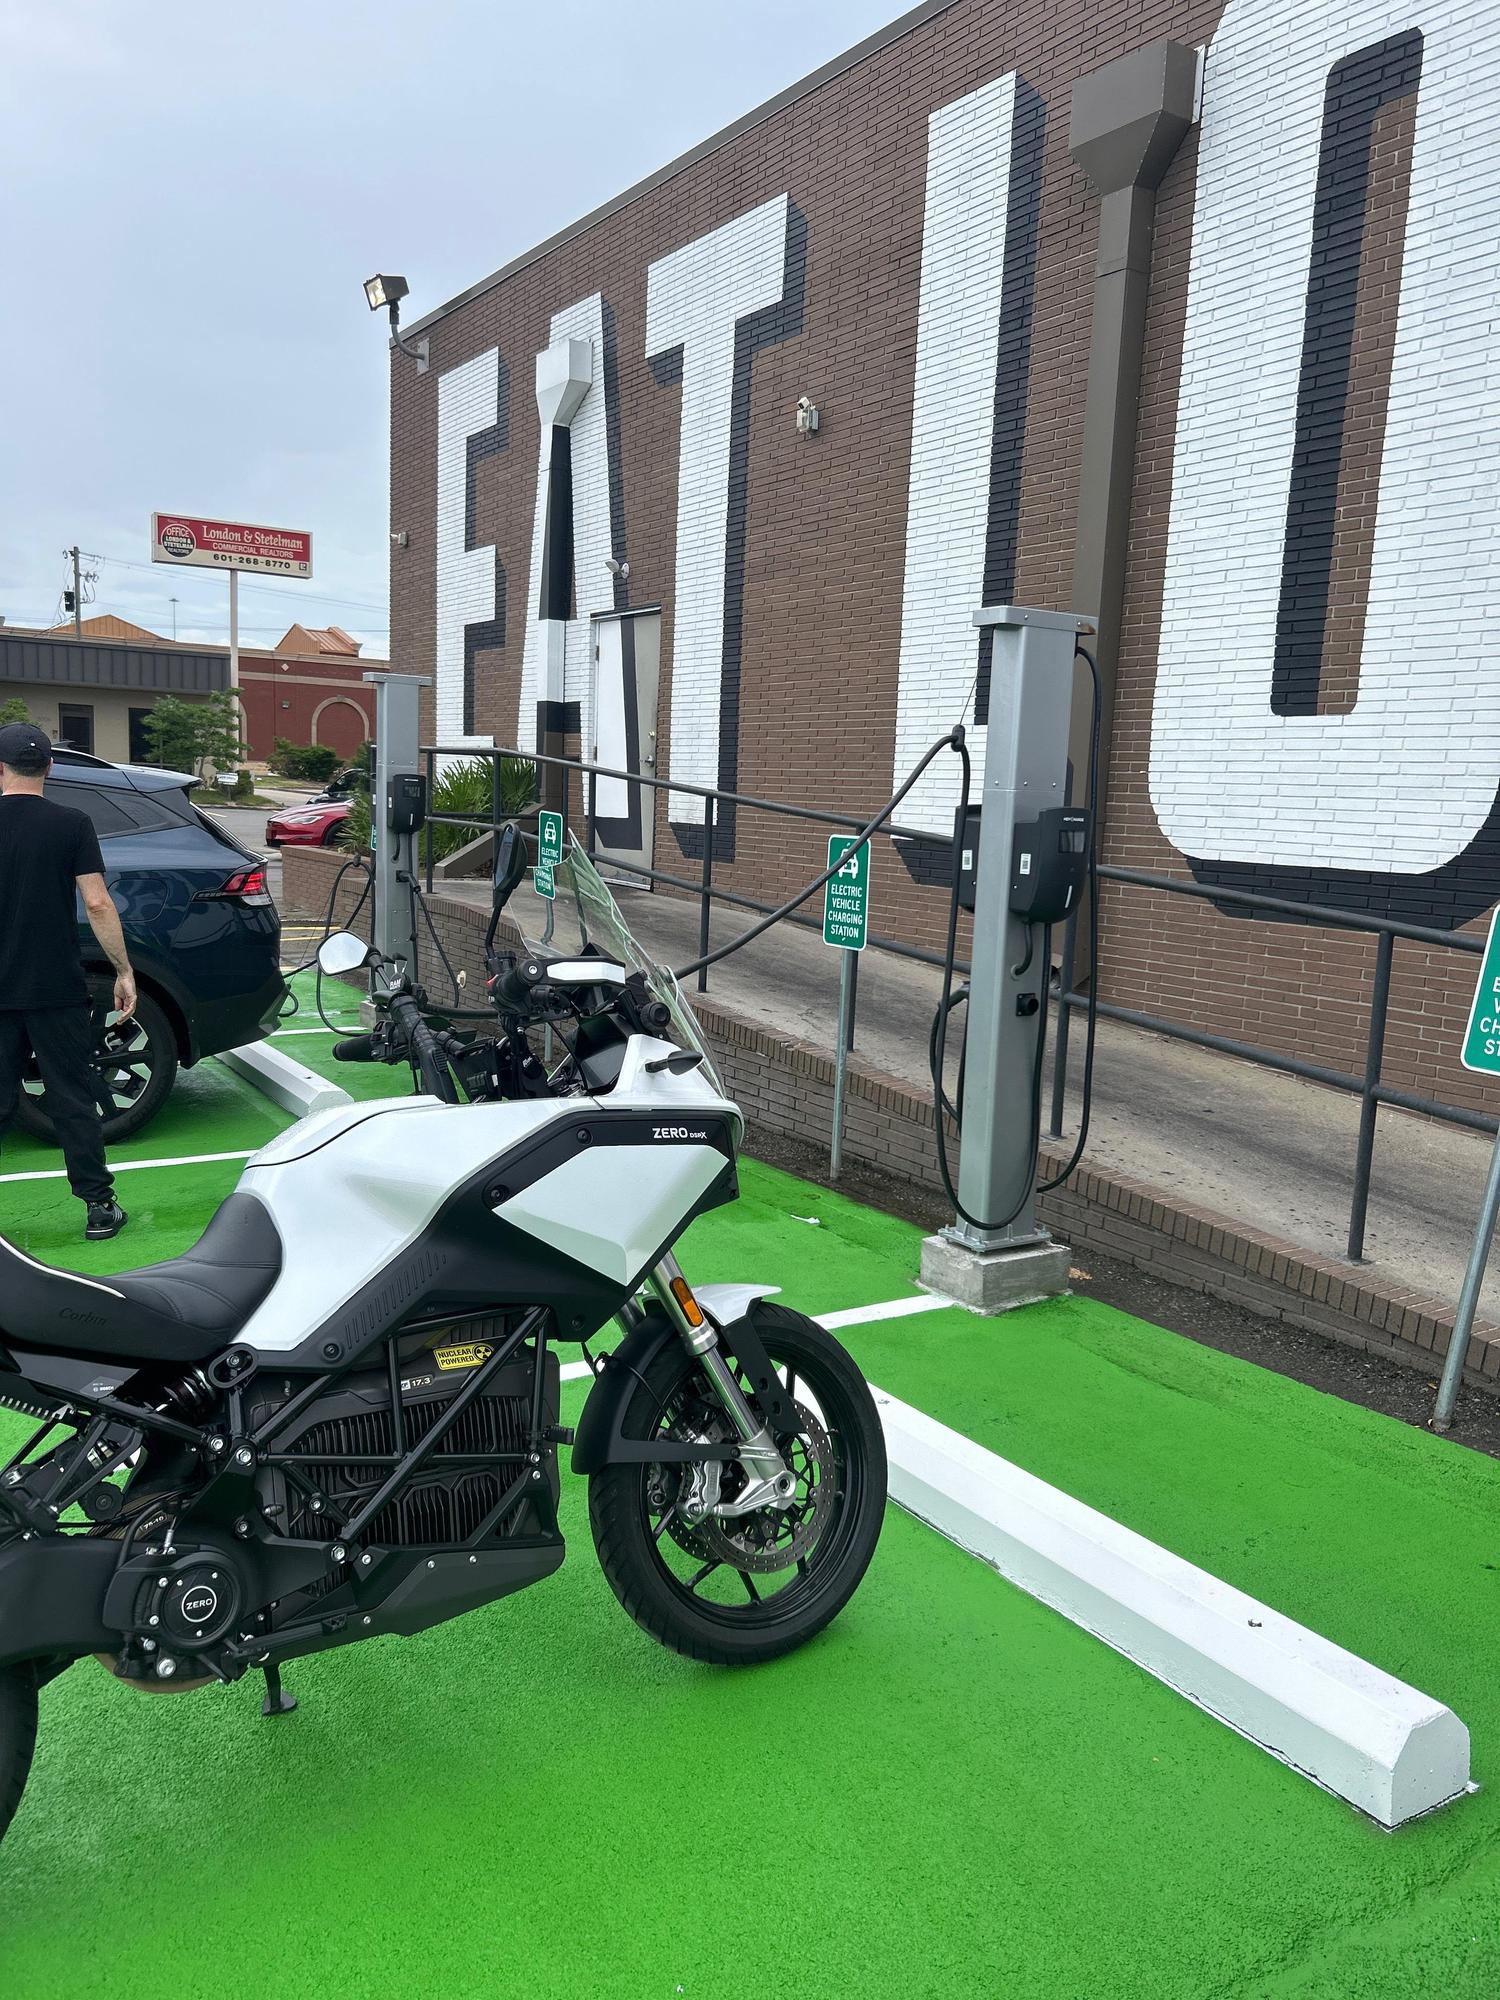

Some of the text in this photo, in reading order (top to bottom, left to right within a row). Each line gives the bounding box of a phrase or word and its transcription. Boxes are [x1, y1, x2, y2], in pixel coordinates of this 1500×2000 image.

[434, 194, 789, 828] EAT
[166, 526, 190, 538] OFFICE
[202, 525, 304, 549] London & Stetelman
[212, 542, 294, 559] COMMERCIAL REALTORS
[213, 553, 291, 569] 601-268-8770
[541, 846, 559, 858] ELECTRIC
[831, 883, 863, 898] ELECTRIC
[831, 897, 861, 912] VEHICLE
[827, 910, 863, 925] CHARGING
[830, 924, 860, 939] STATION
[651, 1127, 688, 1139] ZERO
[438, 1348, 472, 1359] NUCLEAR
[440, 1355, 475, 1366] POWERED
[411, 1376, 432, 1387] 17.3
[185, 1598, 213, 1610] ZERO
